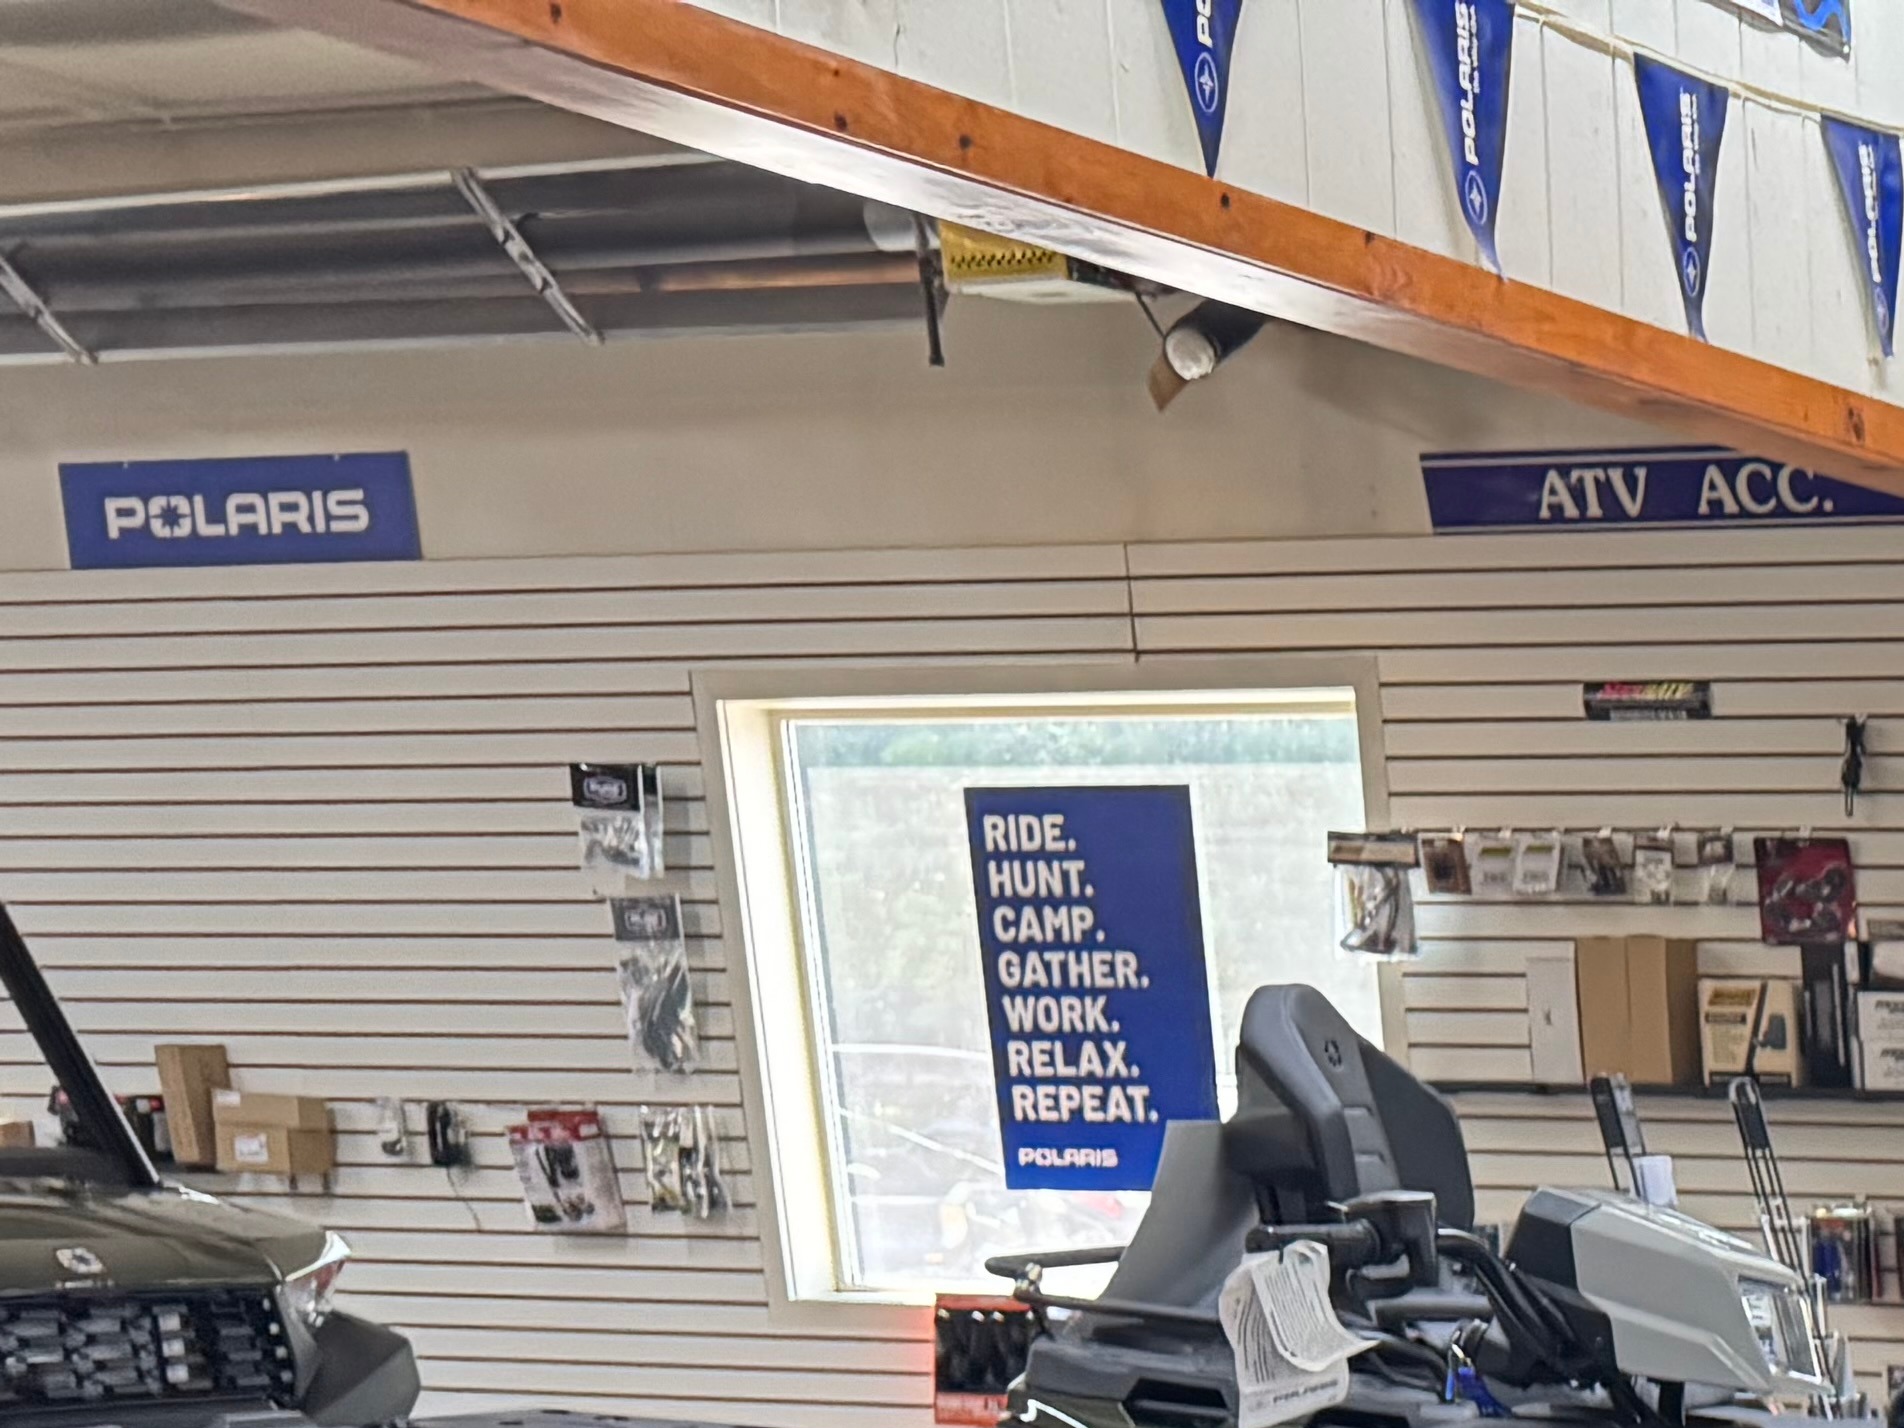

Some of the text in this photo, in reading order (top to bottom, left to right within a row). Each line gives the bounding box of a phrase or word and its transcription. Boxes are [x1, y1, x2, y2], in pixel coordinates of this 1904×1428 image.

[1678, 91, 1698, 243] POLARIS
[1857, 143, 1882, 283] POLARIS
[1538, 459, 1834, 521] ATV ACC.
[104, 487, 370, 541] POLARIS
[983, 814, 1076, 852] RIDE.
[988, 860, 1094, 898] HUNT.
[993, 905, 1105, 944] CAMP.
[998, 950, 1150, 989] GATHER.
[1002, 995, 1120, 1033] WORK.
[1007, 1039, 1140, 1078] RELAX.
[1012, 1084, 1159, 1123] REPEAT.
[1018, 1147, 1119, 1167] POLARIS
